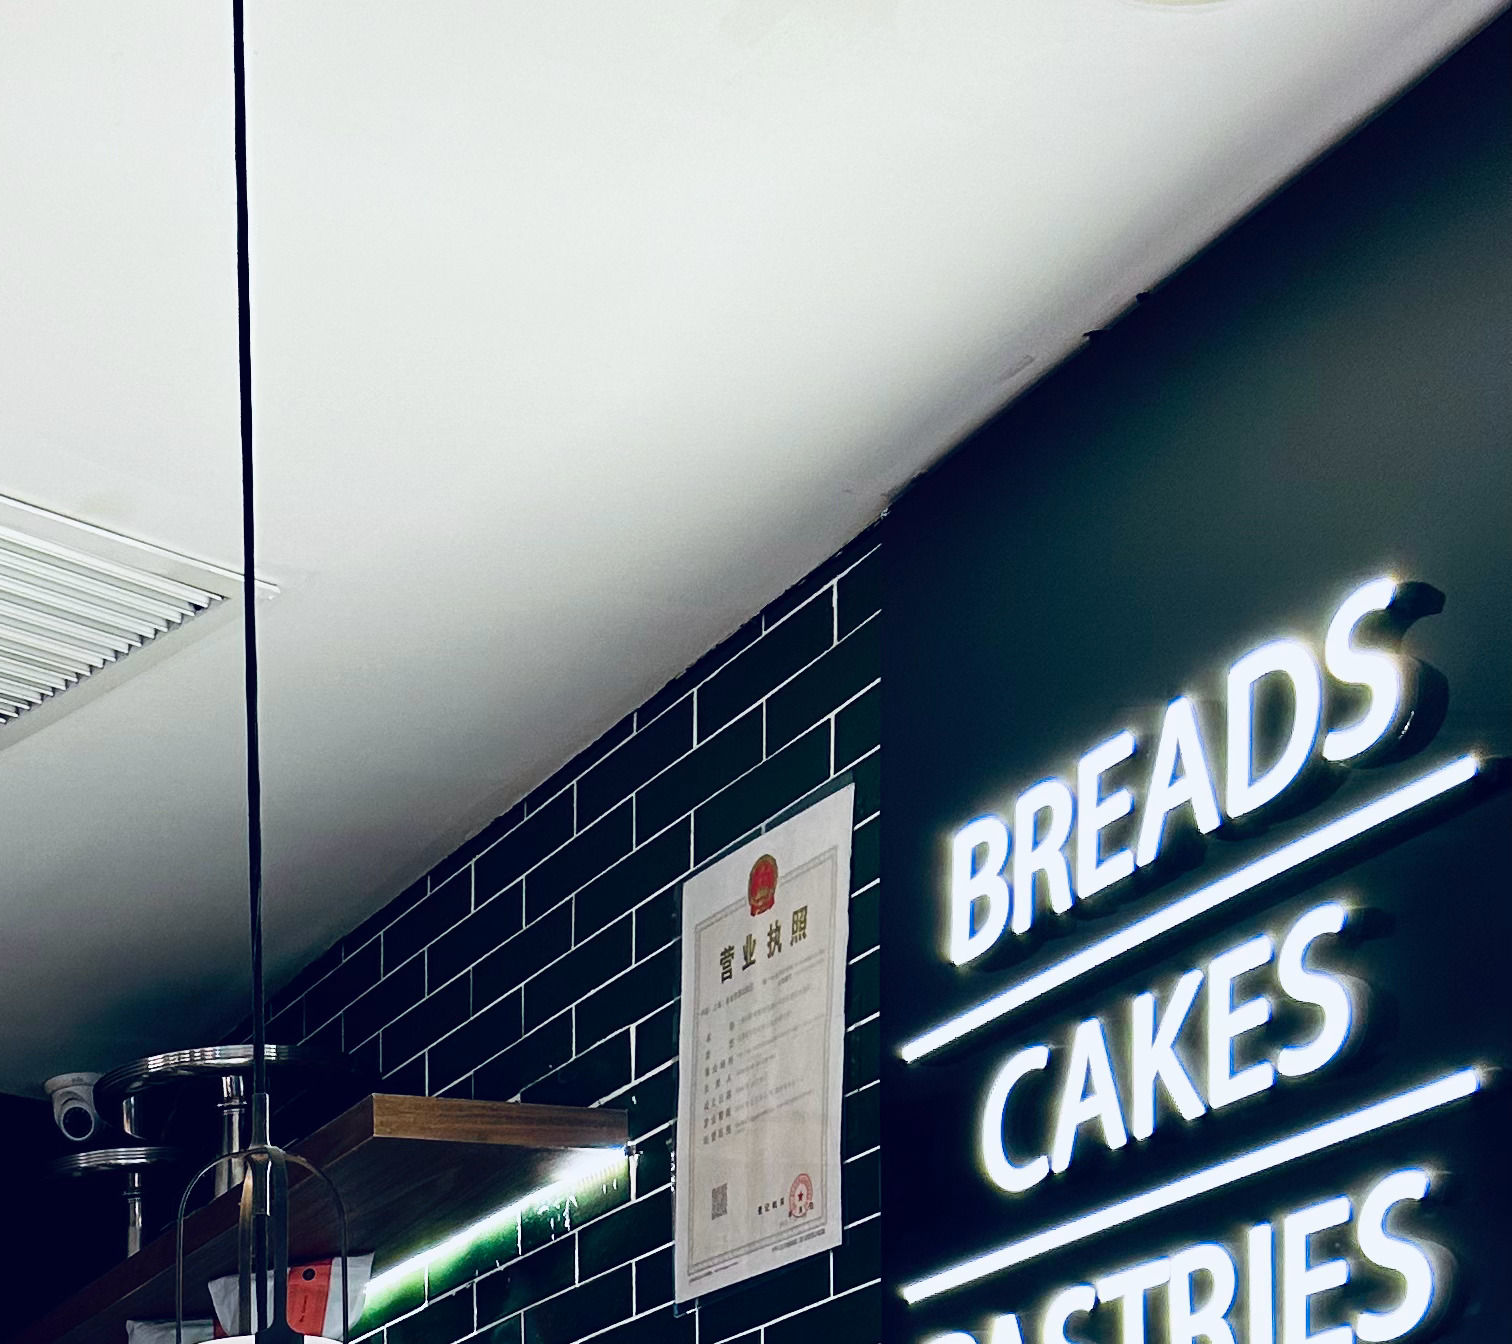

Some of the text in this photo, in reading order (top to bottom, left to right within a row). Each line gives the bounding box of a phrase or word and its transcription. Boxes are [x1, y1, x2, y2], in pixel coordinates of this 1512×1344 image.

[949, 576, 1400, 967] BREADS
[719, 904, 808, 984] 营业执照
[983, 902, 1353, 1195] CAKES
